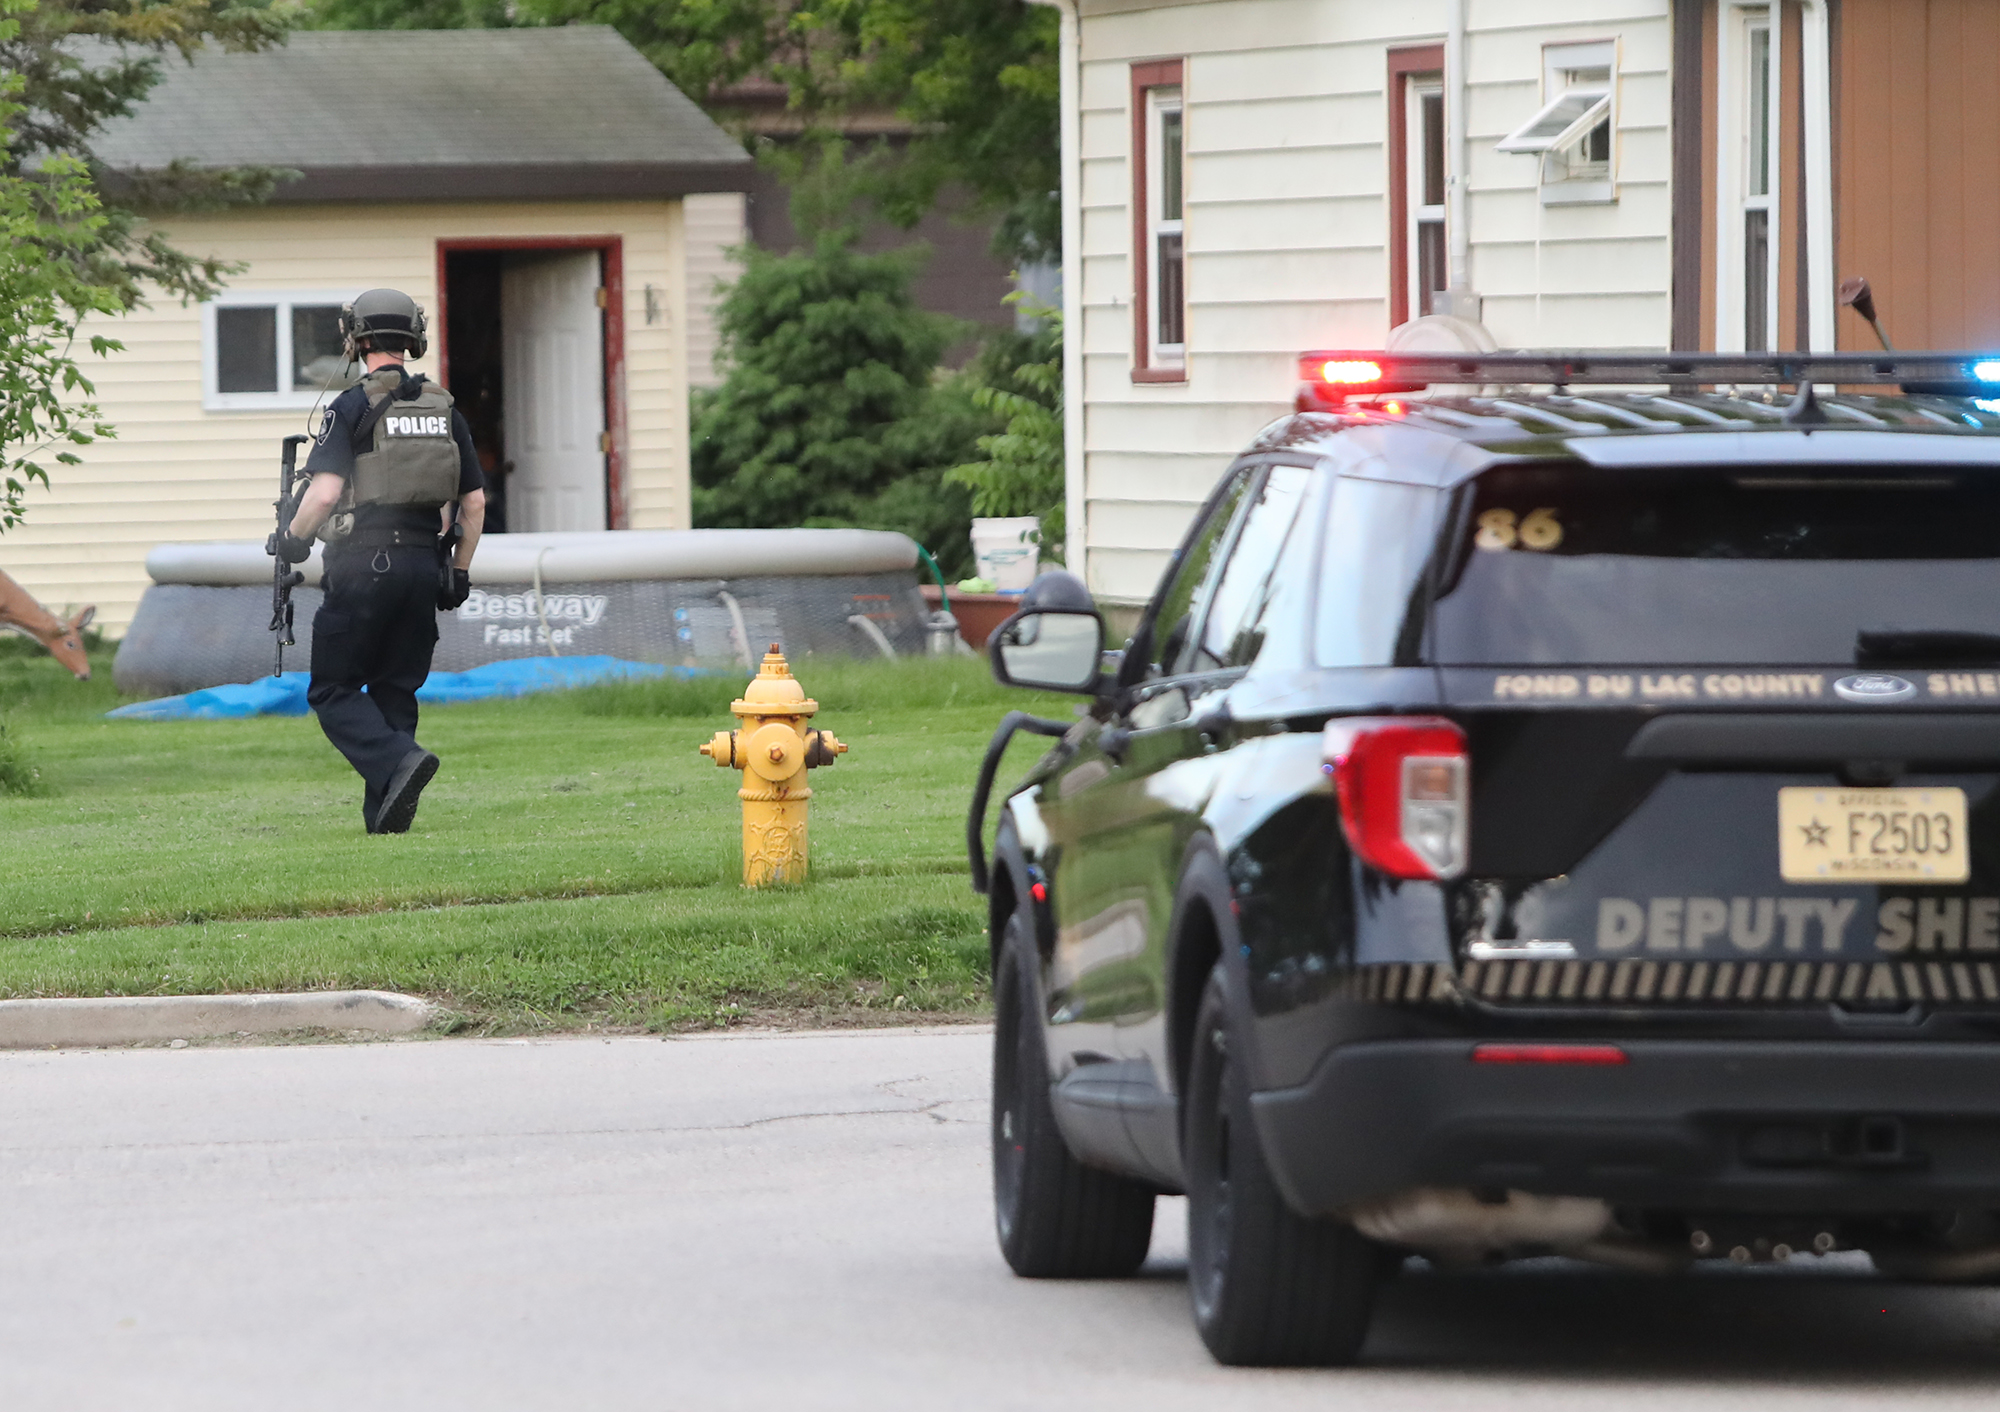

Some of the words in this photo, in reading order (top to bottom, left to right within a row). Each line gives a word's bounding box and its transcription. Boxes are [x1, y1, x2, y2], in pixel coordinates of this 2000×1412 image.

[386, 416, 448, 435] POLICE
[1475, 508, 1564, 551] 86
[459, 590, 607, 624] Bestway
[484, 625, 531, 644] Fast
[537, 625, 573, 644] Set
[1494, 674, 1580, 697] FOND
[1587, 674, 1633, 697] DU
[1639, 674, 1698, 697] LAC
[1703, 674, 1823, 697] COUNTY
[1926, 673, 2000, 697] SHE
[1852, 676, 1896, 693] Ford
[1848, 812, 1953, 854] F2503
[1596, 897, 1858, 951] DEPUTY
